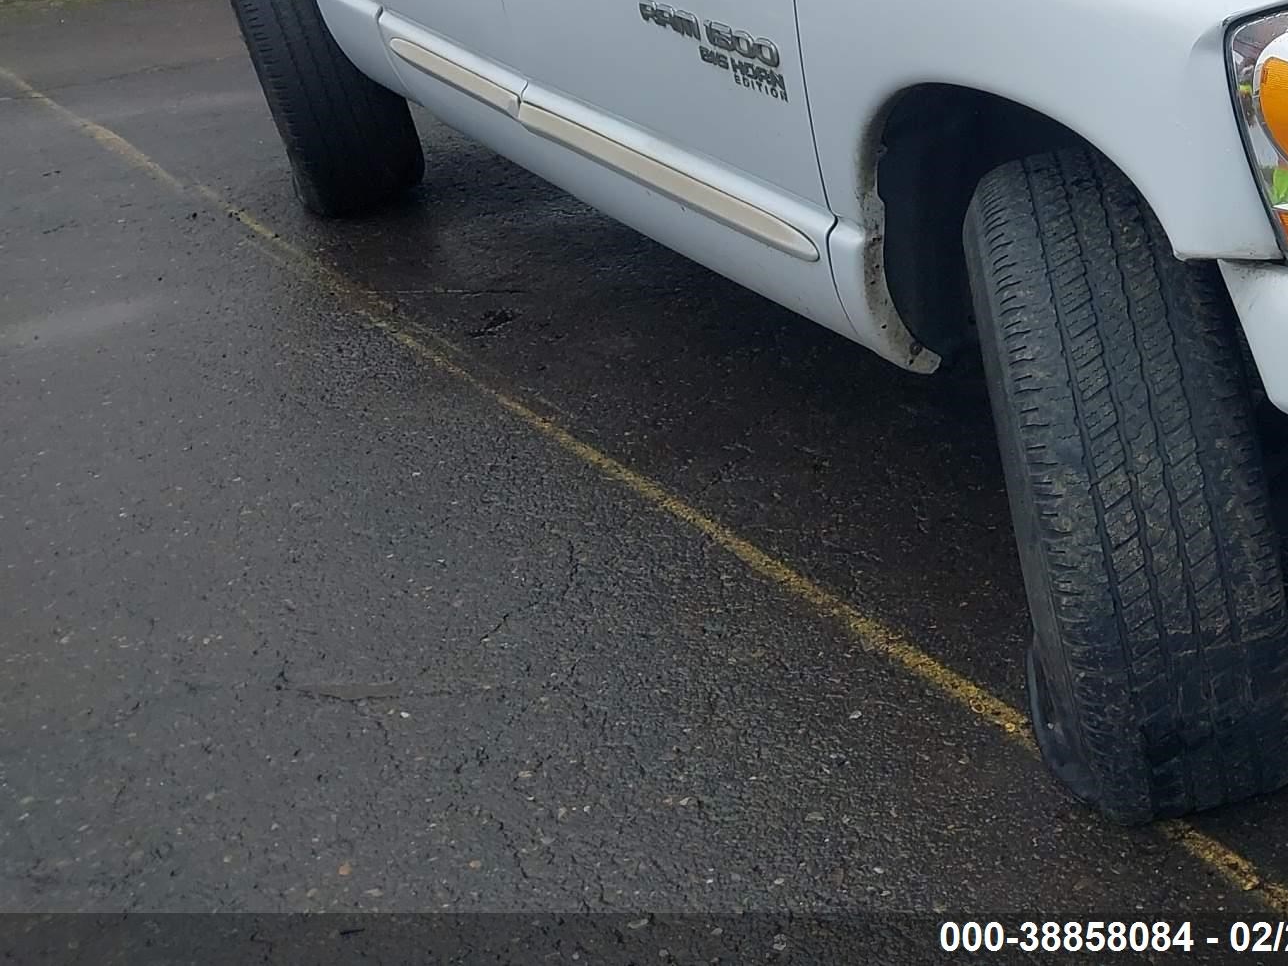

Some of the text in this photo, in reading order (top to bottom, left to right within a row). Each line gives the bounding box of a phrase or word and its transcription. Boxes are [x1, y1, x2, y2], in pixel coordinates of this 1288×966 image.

[703, 19, 780, 69] 1500
[698, 45, 786, 91] BIG HORN
[734, 74, 789, 103] EDITION
